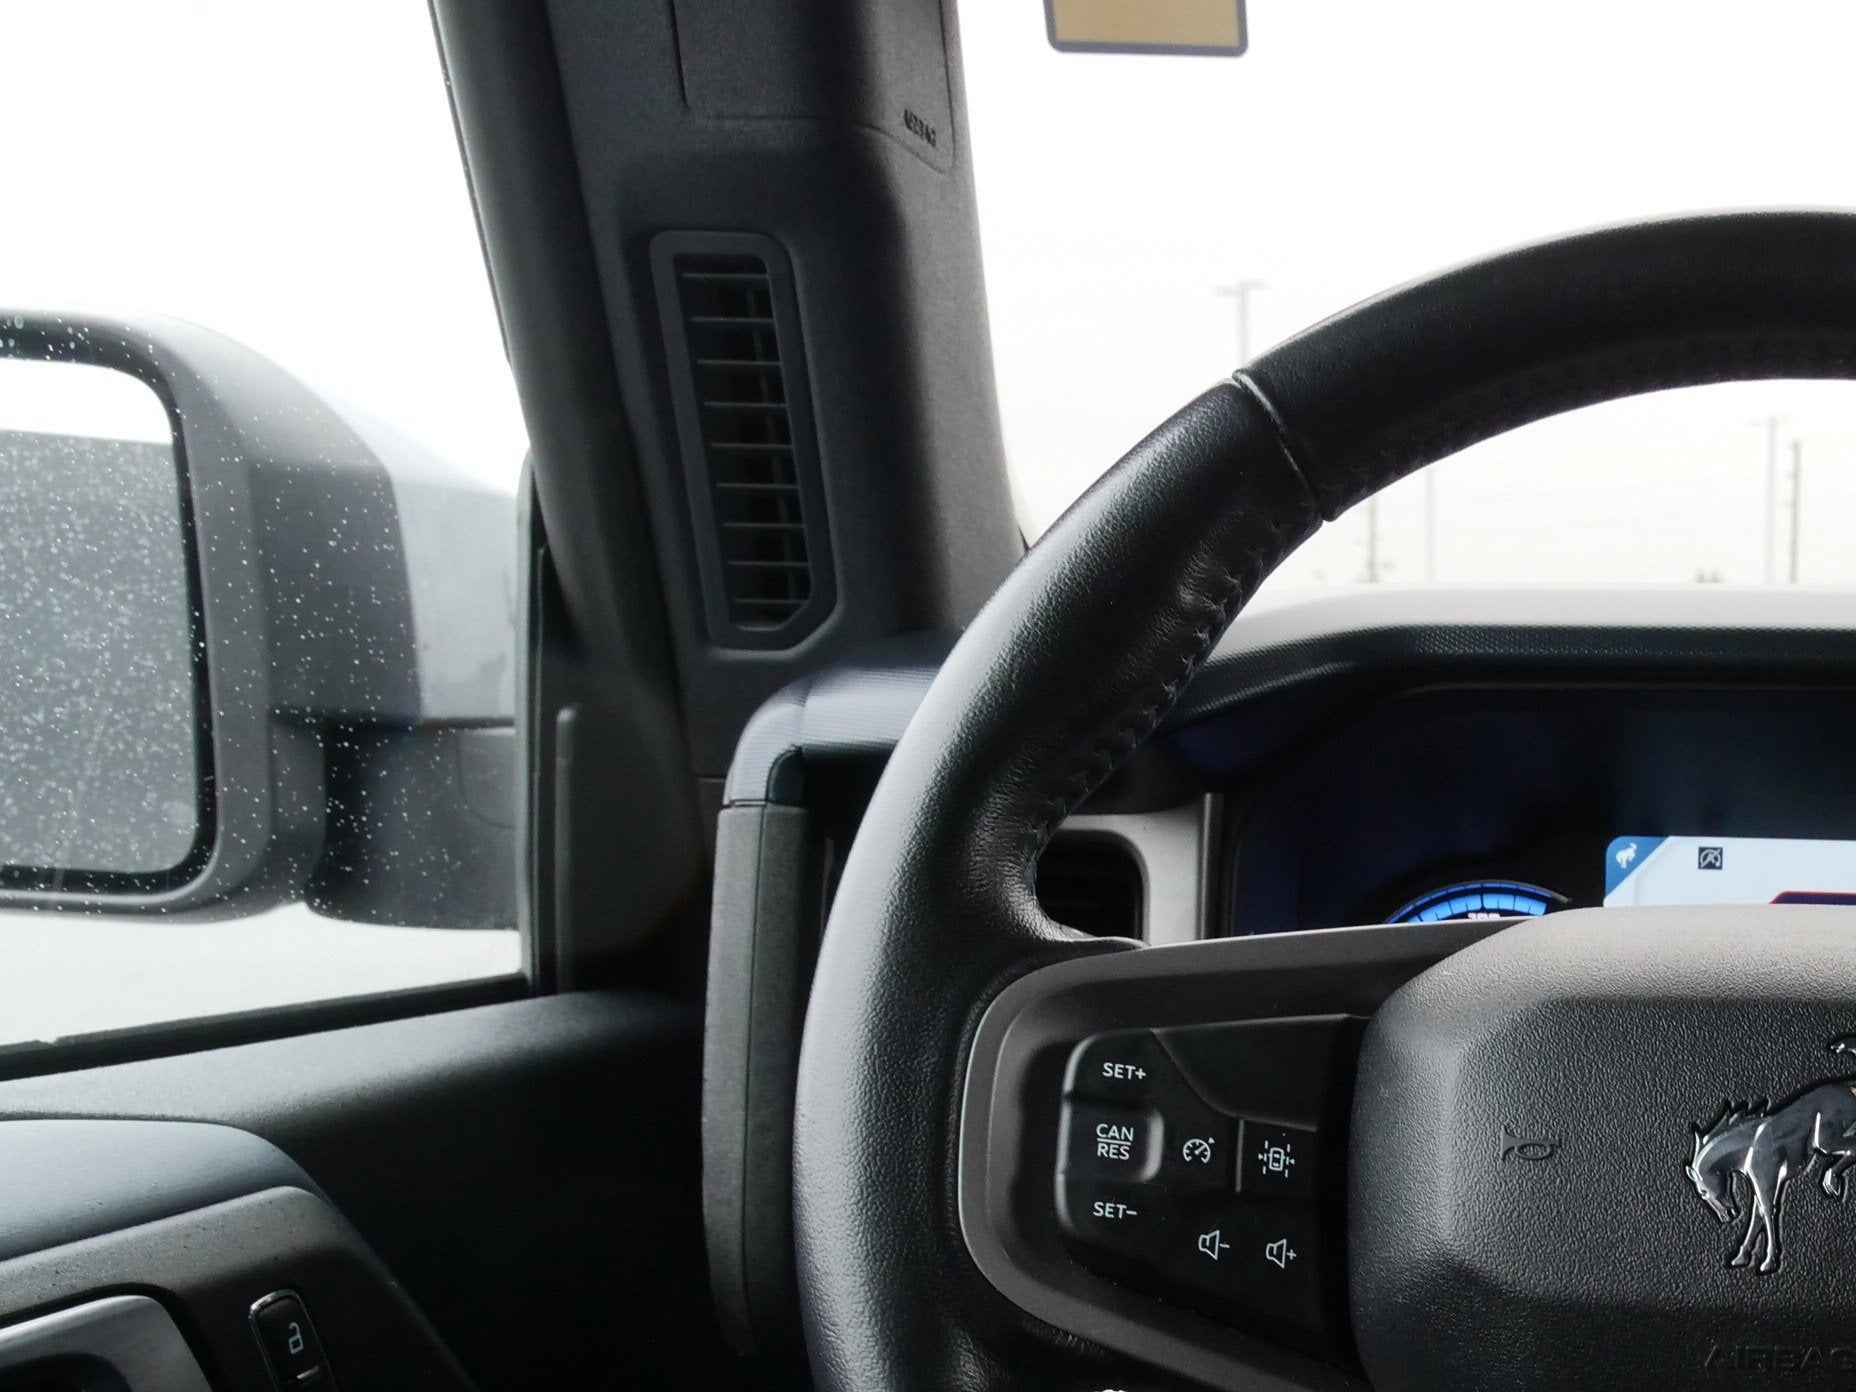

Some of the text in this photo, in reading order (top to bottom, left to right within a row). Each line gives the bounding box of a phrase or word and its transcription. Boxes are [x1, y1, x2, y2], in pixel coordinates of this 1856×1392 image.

[1102, 1061, 1147, 1081] SET+
[1096, 1123, 1135, 1142] CAN
[1097, 1142, 1130, 1161] RES
[1703, 1344, 1856, 1370] AIRBAG
